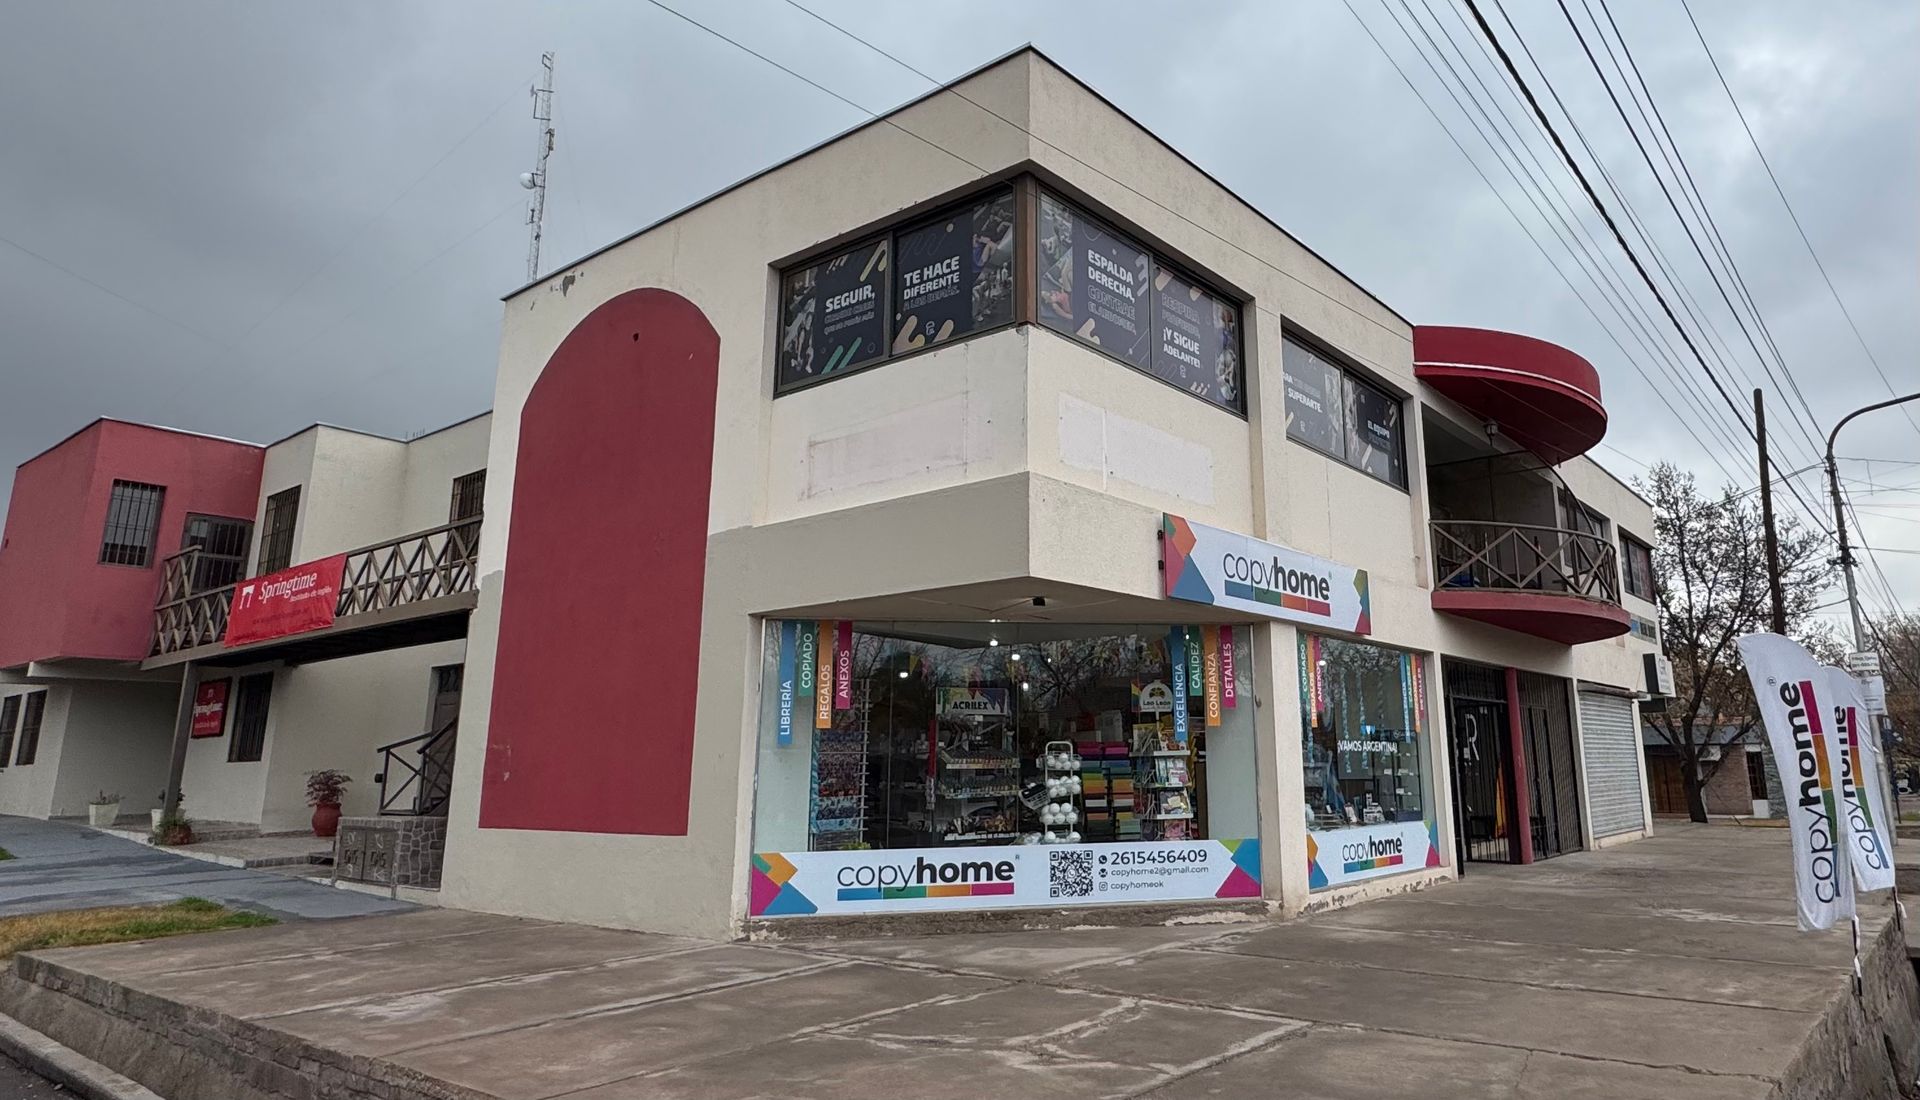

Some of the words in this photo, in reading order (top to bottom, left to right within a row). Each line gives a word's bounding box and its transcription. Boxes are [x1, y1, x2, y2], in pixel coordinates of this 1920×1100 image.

[903, 269, 921, 287] TE
[923, 255, 960, 281] HACE
[903, 271, 960, 300] DIFERENTE
[1087, 249, 1134, 286] ESPALDA
[1088, 266, 1136, 304] DERECHA,
[825, 284, 876, 313] SEGUIR,
[1173, 331, 1200, 355] SIGUE
[258, 571, 318, 604] Springtime
[1222, 552, 1331, 601] copyhome
[802, 633, 813, 689] COPIADO
[839, 650, 850, 698] ANEXOS
[1190, 641, 1201, 689] CALIDEZ
[1222, 643, 1234, 698] DETALLES
[820, 664, 831, 720] REGALOS
[1174, 663, 1187, 733] EXCELENCIA
[1207, 652, 1218, 718] CONFIANZA
[780, 680, 792, 736] LIBRERÍA
[952, 701, 989, 711] ACRILEX
[1779, 681, 1836, 904] copyhome
[1110, 848, 1208, 866] 2615456409
[1341, 834, 1403, 865] copyhome
[836, 856, 1015, 893] copyhome
[1110, 866, 1209, 878] copyhome2@gmail.com
[1110, 880, 1164, 892] copyhomeok
